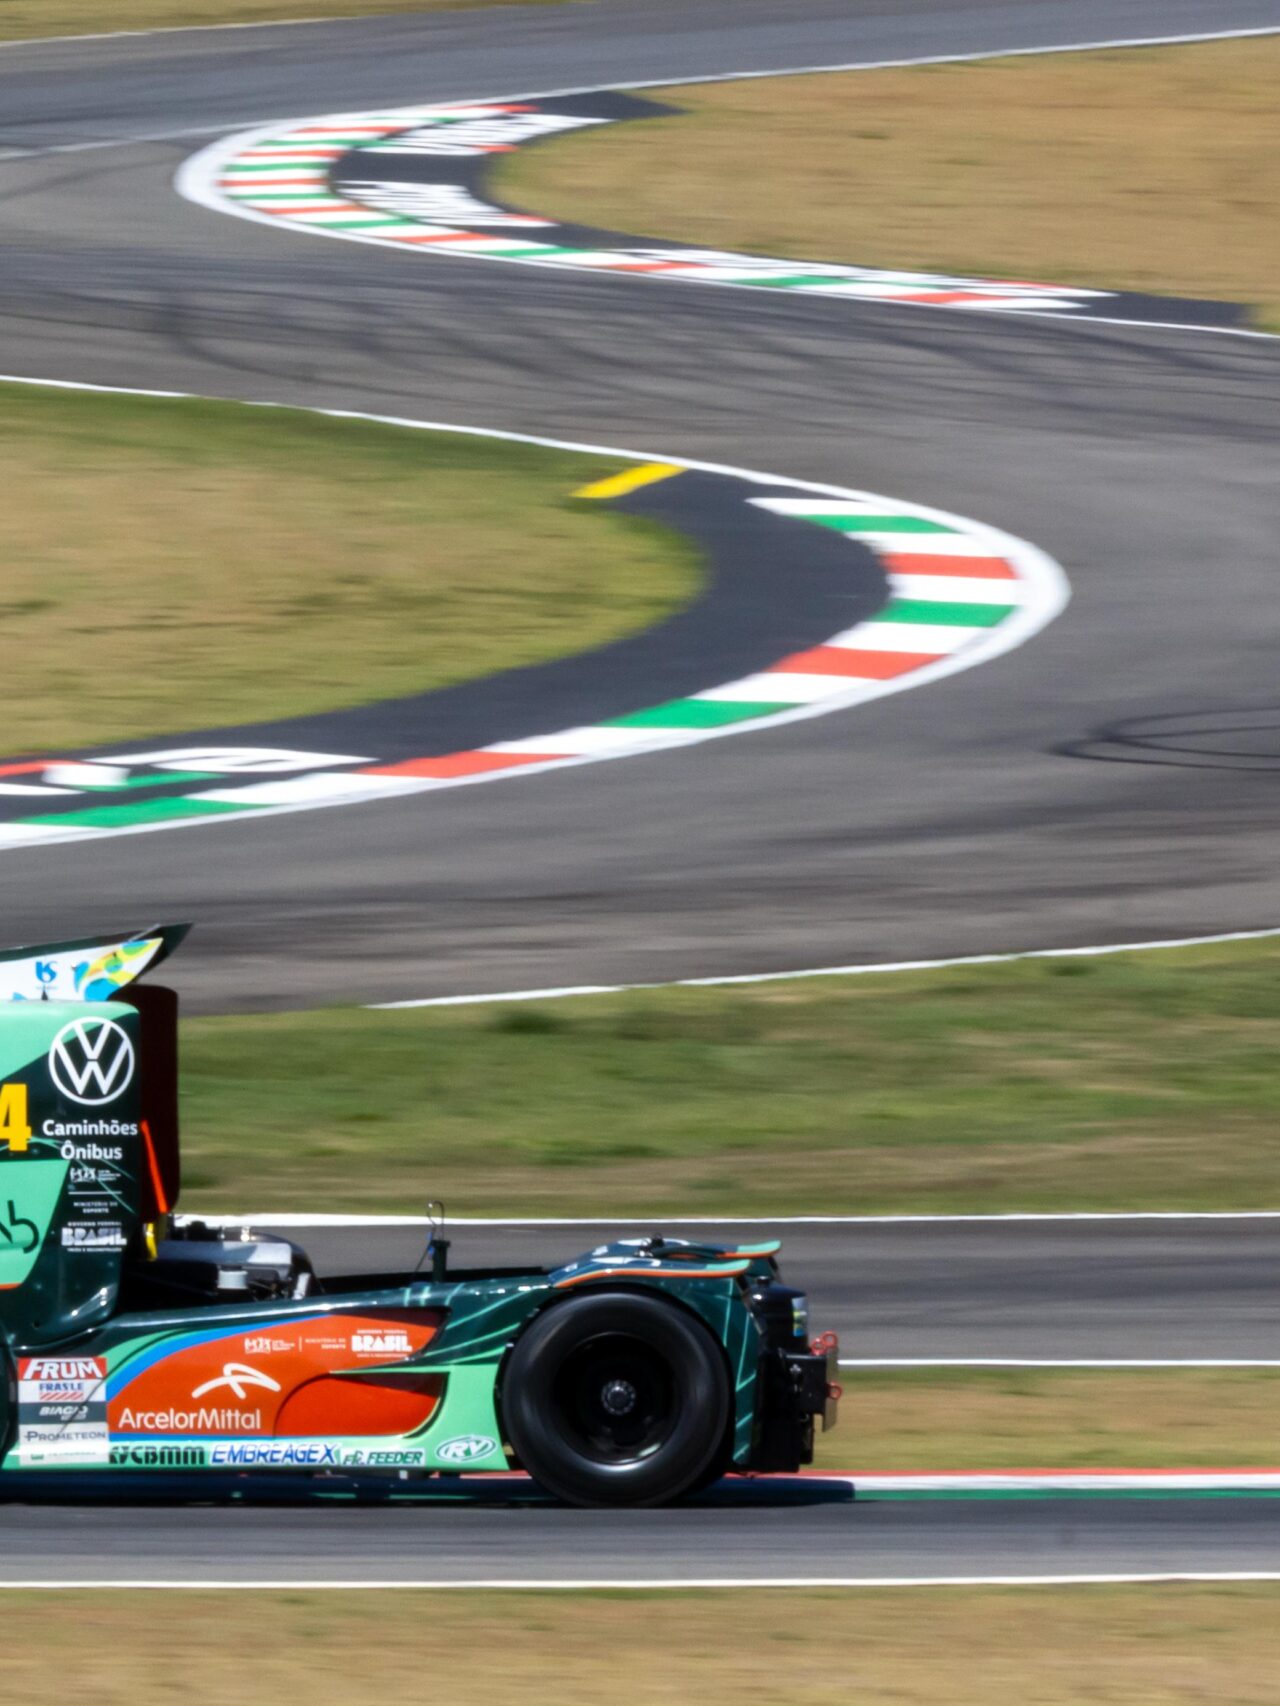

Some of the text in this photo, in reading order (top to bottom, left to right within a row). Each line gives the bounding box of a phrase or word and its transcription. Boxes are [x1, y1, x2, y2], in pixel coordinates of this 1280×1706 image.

[42, 1119, 138, 1136] Caminhões
[60, 1139, 123, 1160] Ônibus
[351, 1335, 413, 1352] BRASIL
[23, 1358, 104, 1380] FRUM
[119, 1408, 261, 1430] ArcelorMittal
[211, 1443, 337, 1464] EMBREAGEX
